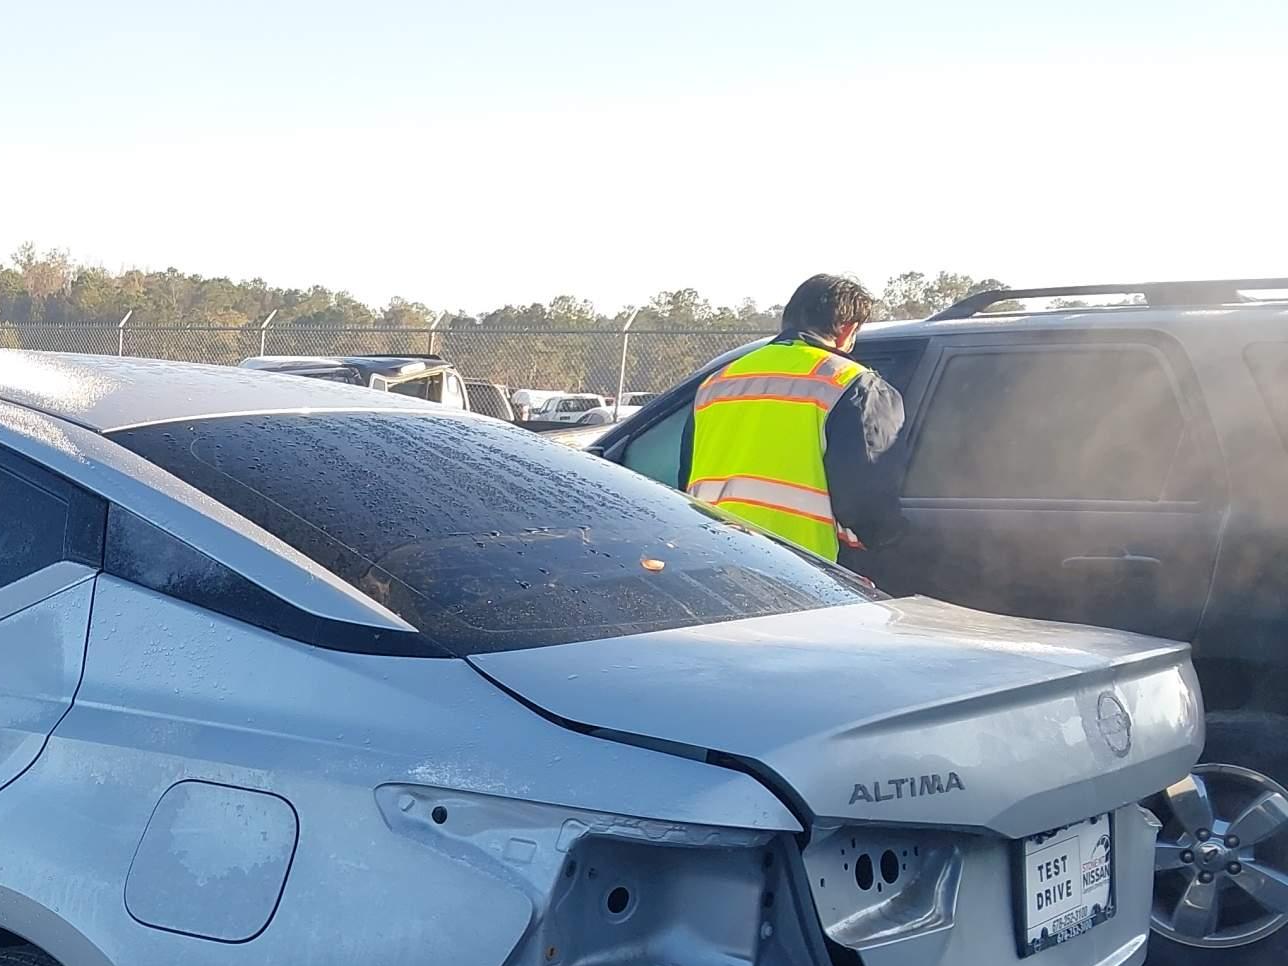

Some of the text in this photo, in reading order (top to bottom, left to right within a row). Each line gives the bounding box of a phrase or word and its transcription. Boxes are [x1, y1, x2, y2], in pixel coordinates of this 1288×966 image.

[848, 771, 966, 805] ALTIMA
[1037, 855, 1068, 882] TEST
[1082, 863, 1110, 889] NISSAN
[1036, 879, 1072, 911] DRIVE
